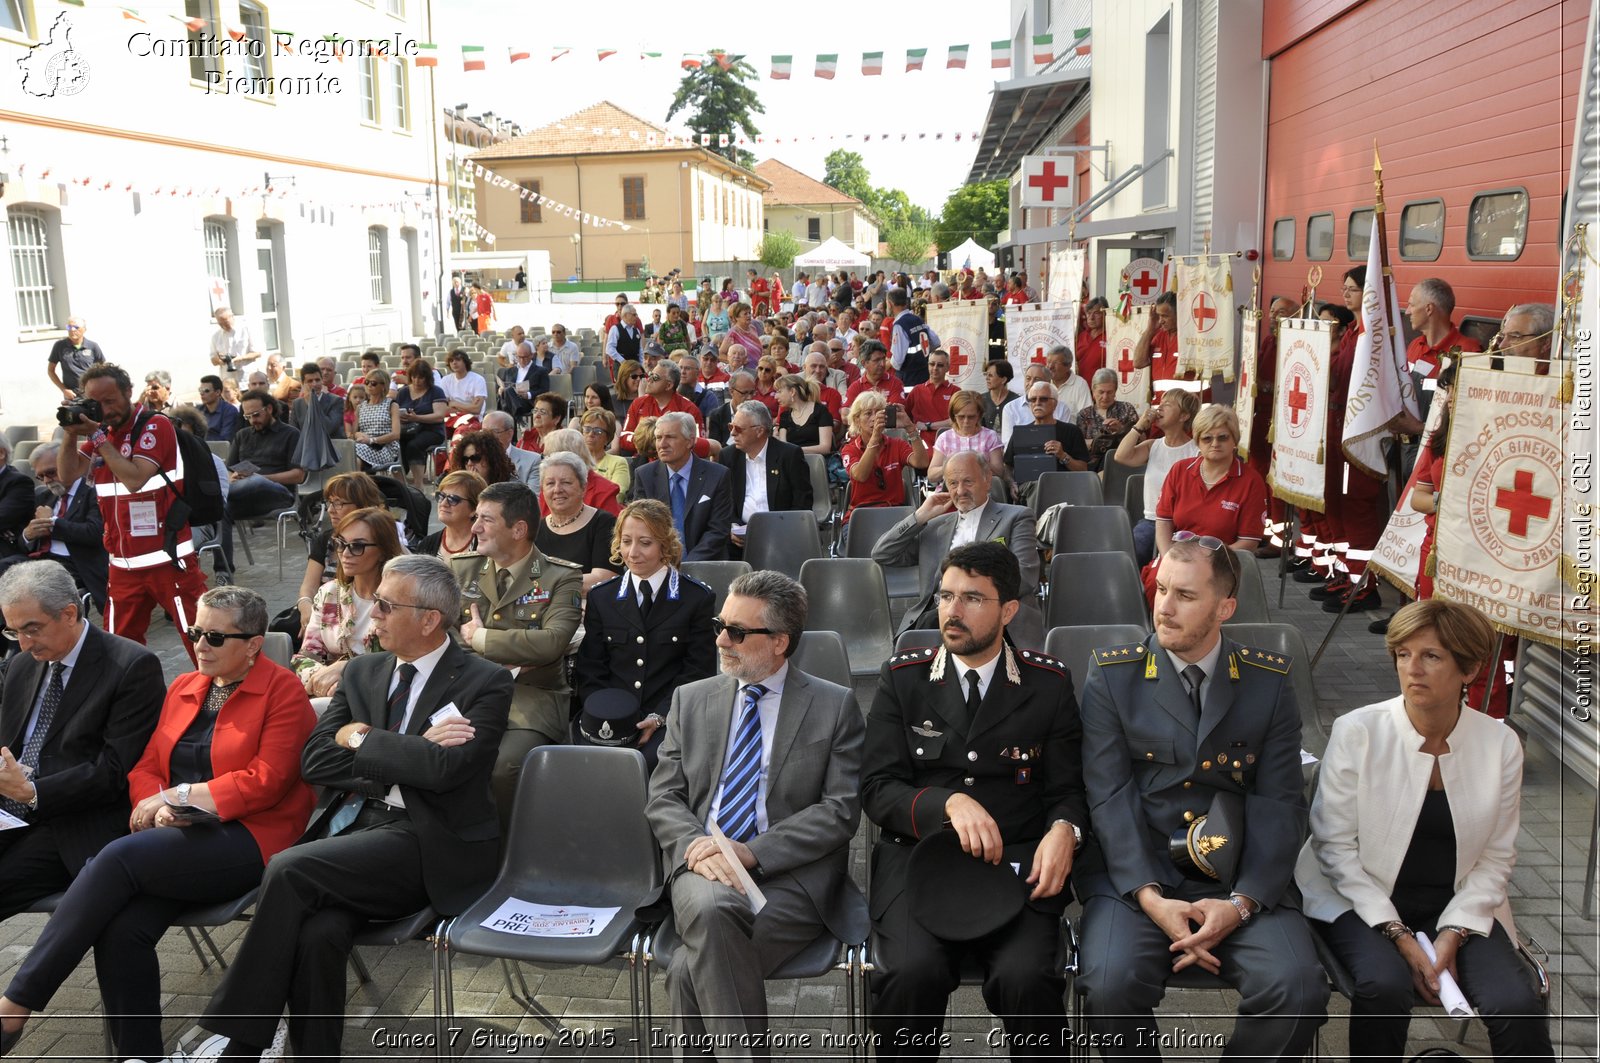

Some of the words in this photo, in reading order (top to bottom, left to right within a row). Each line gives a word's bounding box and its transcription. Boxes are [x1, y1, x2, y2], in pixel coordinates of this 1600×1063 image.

[1467, 386, 1493, 402] CORPO
[1494, 390, 1544, 408] VOLONTARI
[1452, 423, 1494, 477] CROCE
[1494, 410, 1554, 433] ROSSA
[1472, 462, 1504, 557] CONVENZIONE
[1493, 446, 1504, 462] DI
[1508, 440, 1561, 473] GINEVRA
[1375, 541, 1408, 568] AGNO
[1406, 543, 1417, 557] DI
[1523, 544, 1553, 567] 1864
[1438, 560, 1503, 595] GRUPPO
[1506, 583, 1525, 600] DI
[1438, 578, 1508, 619] COMITATO
[492, 919, 529, 933] PRE
[509, 912, 534, 924] RIS
